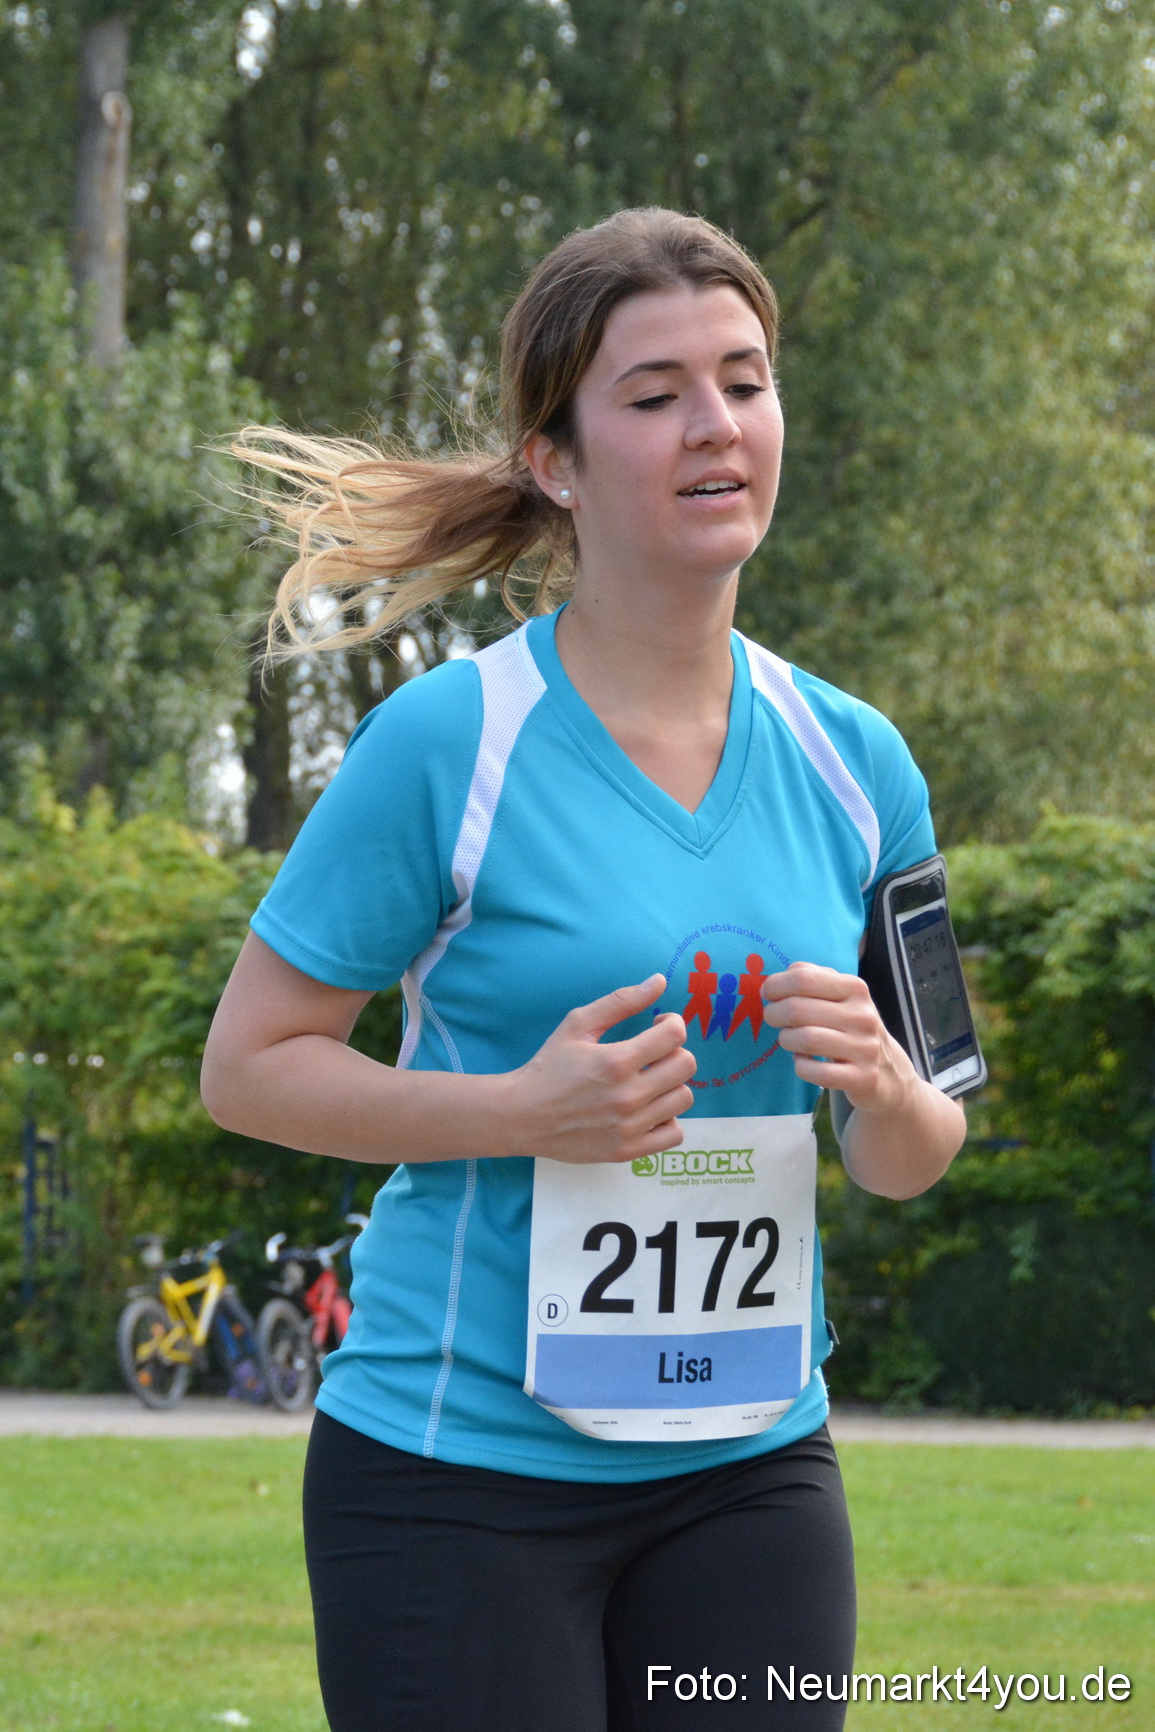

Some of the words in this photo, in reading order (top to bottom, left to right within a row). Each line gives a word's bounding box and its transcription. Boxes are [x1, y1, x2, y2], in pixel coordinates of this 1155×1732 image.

[664, 929, 700, 992] erninitiative
[701, 923, 767, 944] krebskranker
[660, 1149, 755, 1176] BOCK
[660, 1177, 690, 1187] inspired
[691, 1177, 700, 1187] by
[702, 1177, 723, 1185] smart
[725, 1176, 755, 1185] concepts
[579, 1216, 780, 1314] 2172
[547, 1302, 558, 1319] D
[657, 1351, 713, 1384] Lisa
